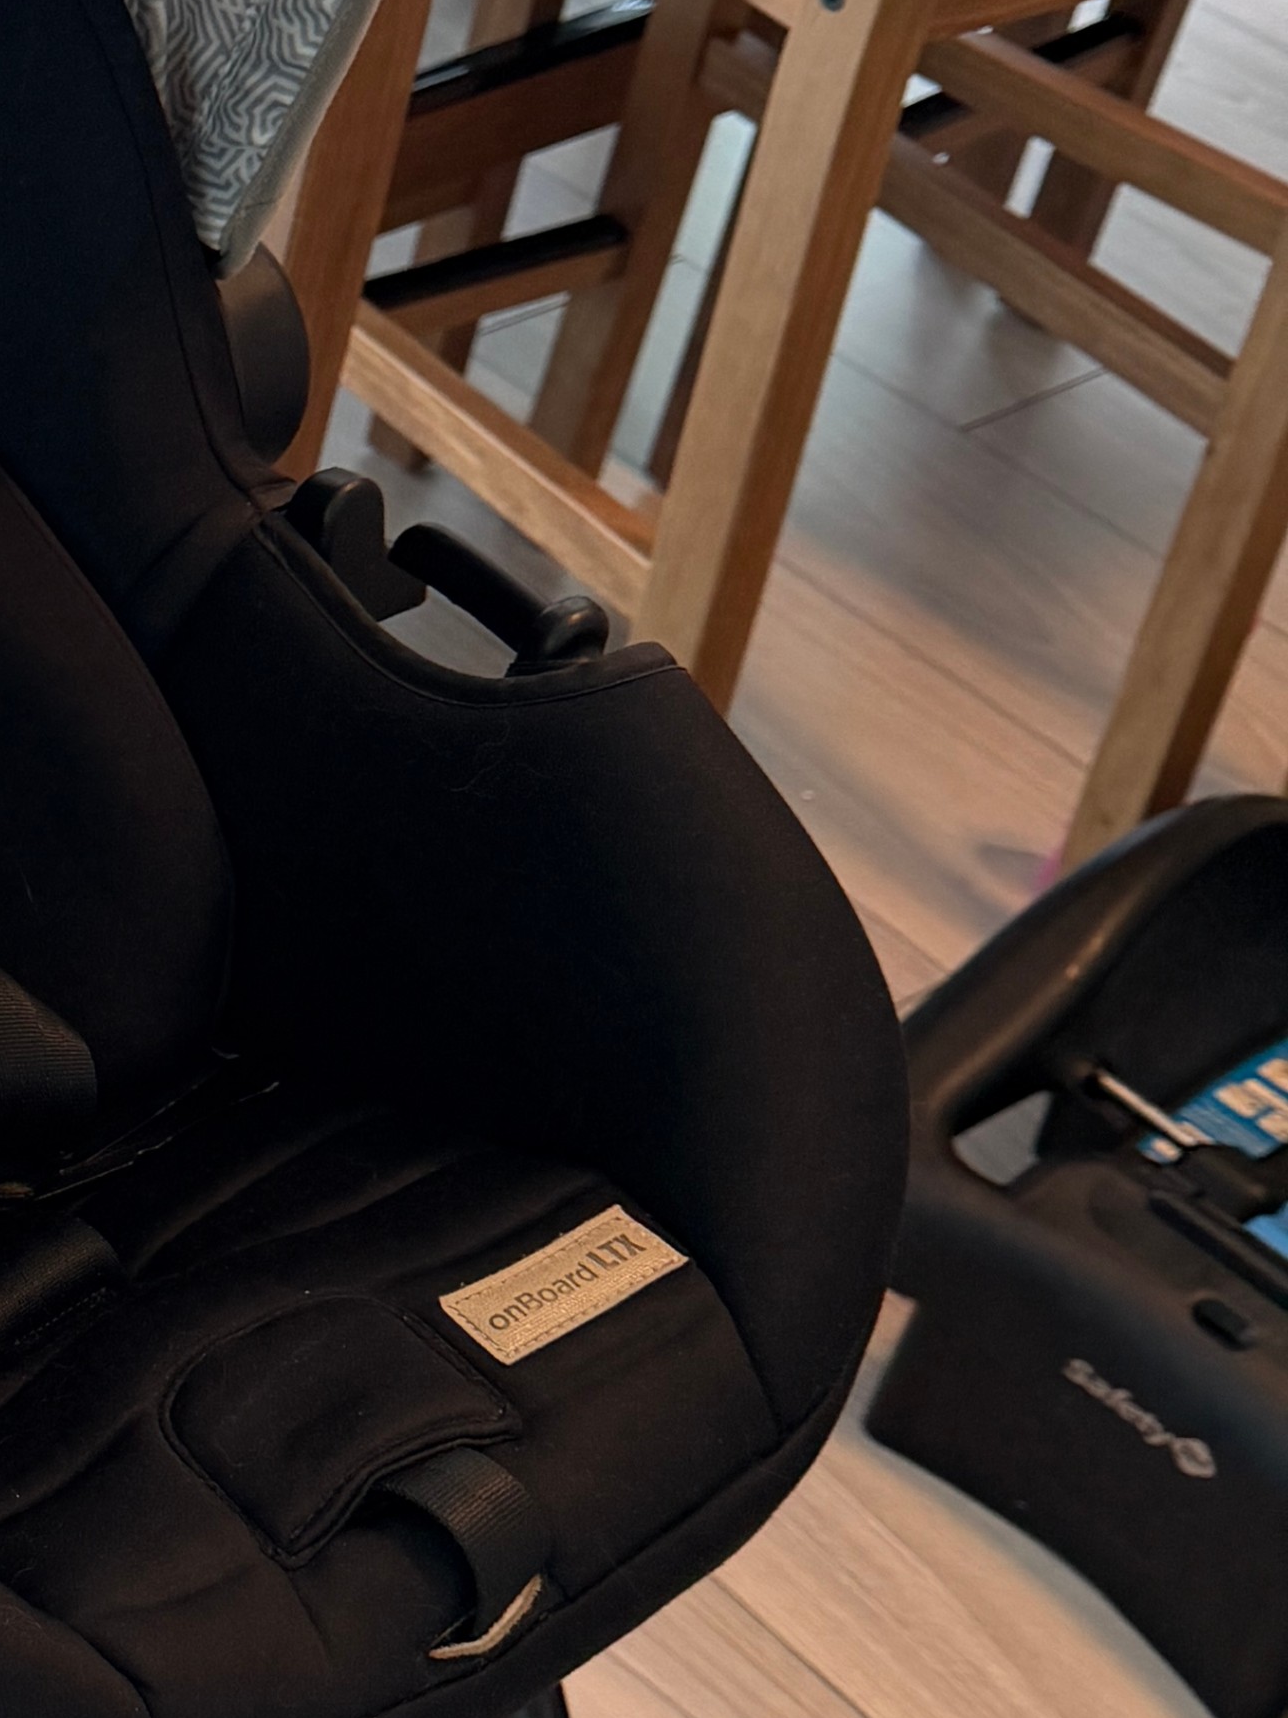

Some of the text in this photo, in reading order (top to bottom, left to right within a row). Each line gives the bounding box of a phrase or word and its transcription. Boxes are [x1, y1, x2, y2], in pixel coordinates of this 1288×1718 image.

[488, 1233, 647, 1332] onBoard LTX
[1062, 1358, 1175, 1447] Safety
